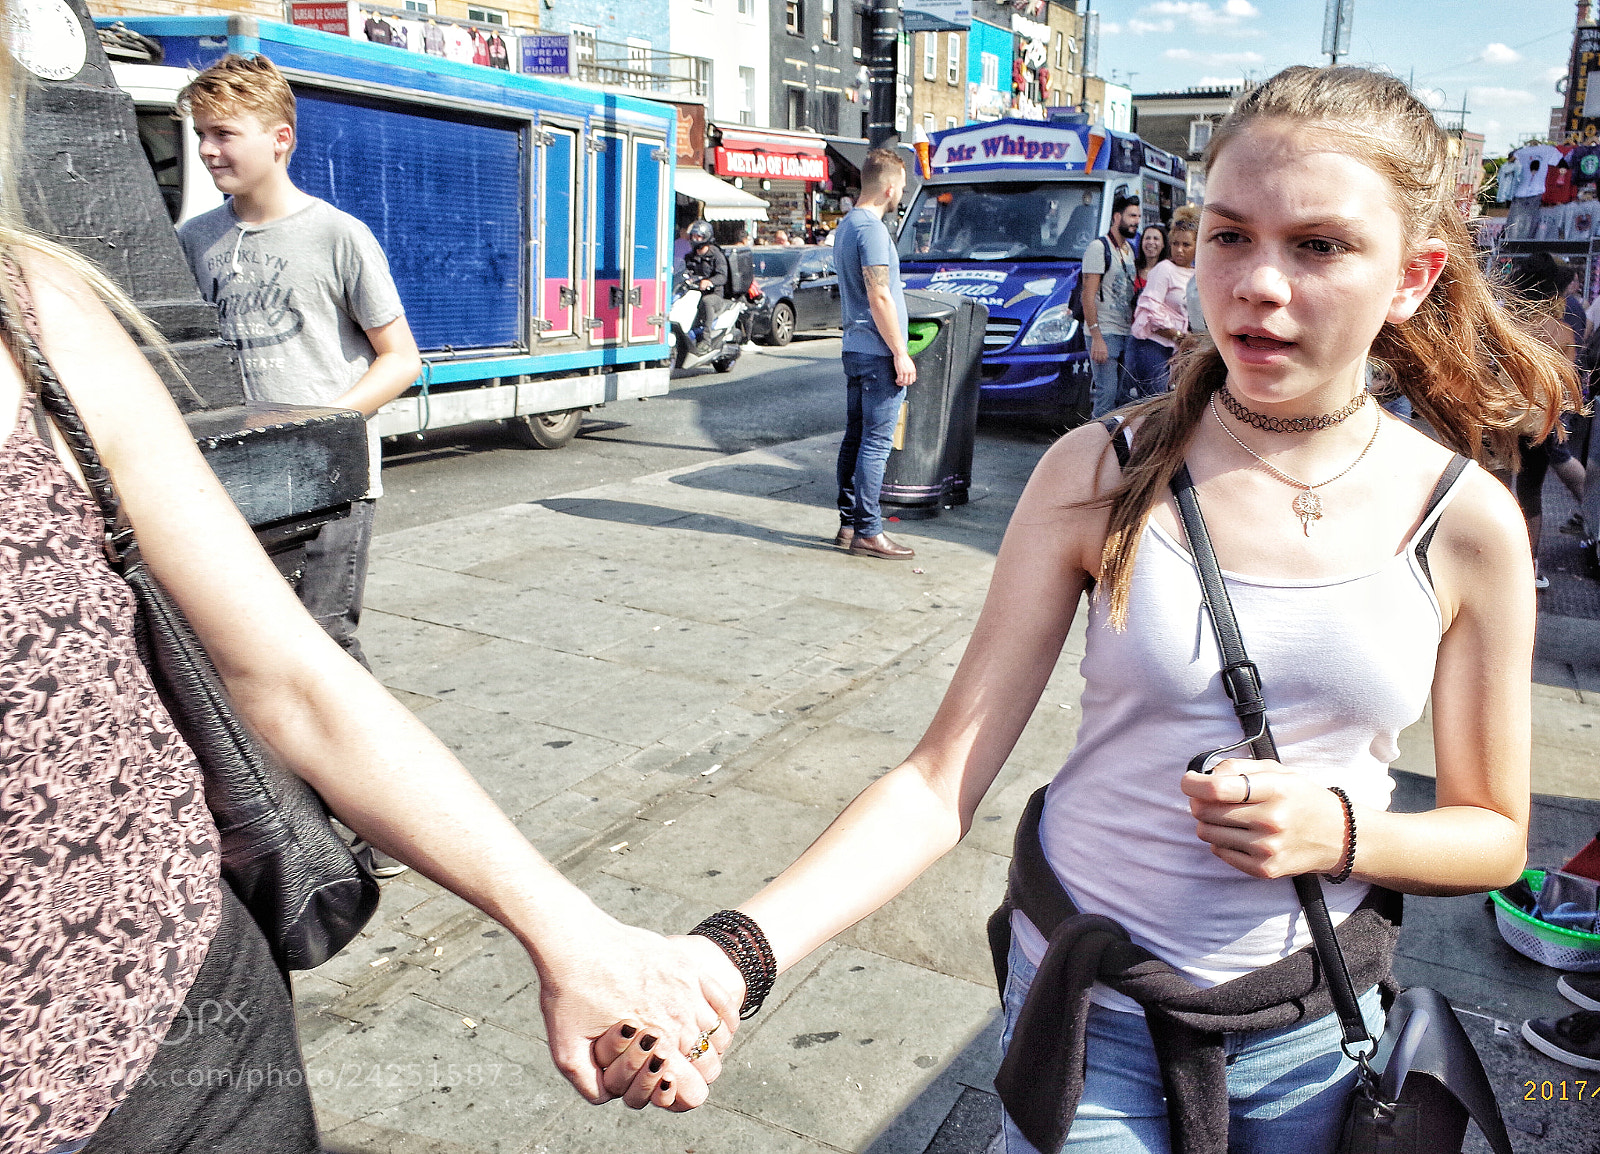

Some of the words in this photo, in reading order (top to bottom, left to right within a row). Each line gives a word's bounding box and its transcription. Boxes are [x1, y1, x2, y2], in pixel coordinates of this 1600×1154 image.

[524, 49, 567, 57] BUREAU
[538, 57, 552, 66] DE
[524, 65, 567, 74] CHANGE
[946, 143, 977, 163] Mr
[981, 134, 1070, 160] Whippy
[767, 155, 782, 176] OF
[782, 156, 824, 178] LONDON
